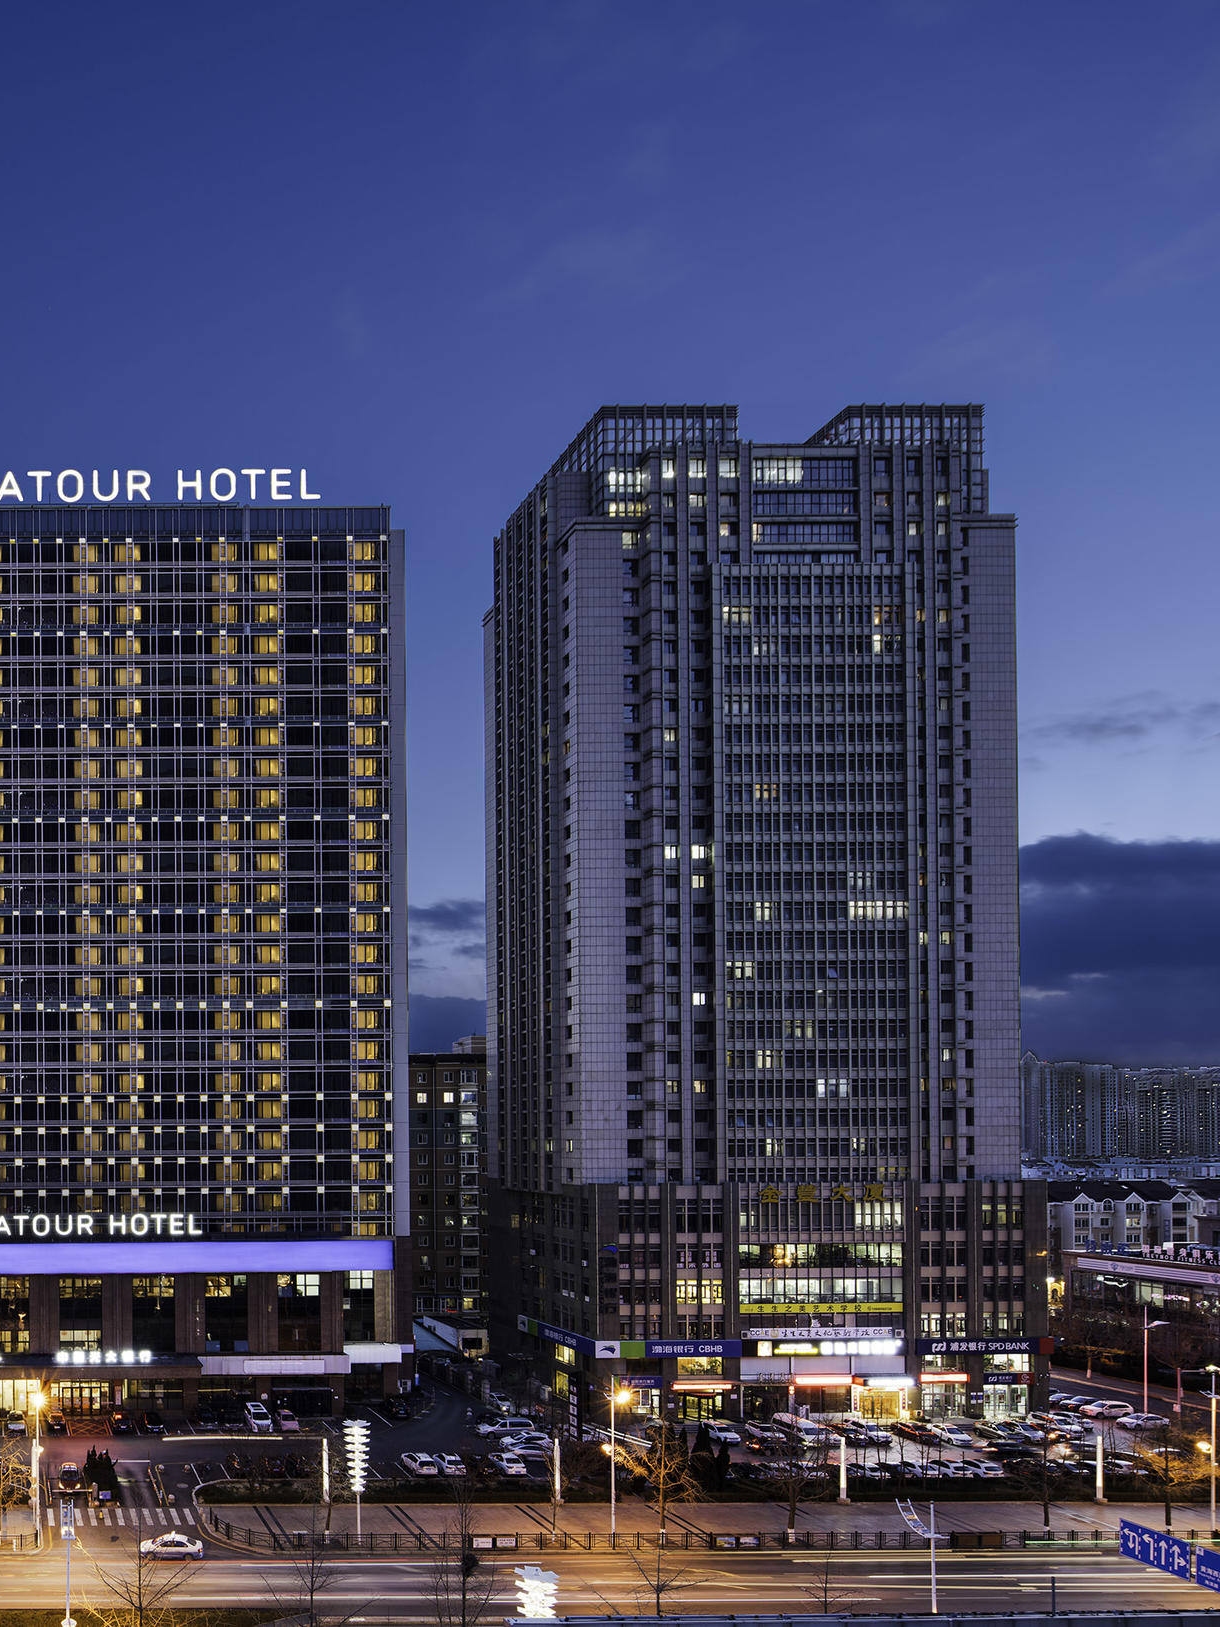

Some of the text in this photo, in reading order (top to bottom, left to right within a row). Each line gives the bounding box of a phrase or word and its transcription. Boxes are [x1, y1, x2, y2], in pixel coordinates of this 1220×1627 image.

[177, 468, 322, 502] HOTEL
[108, 1213, 203, 1236] HOTEL
[651, 1345, 723, 1353] 渤海银行 CBHB
[950, 1341, 1030, 1351] 浦发银行 SPD BANK
